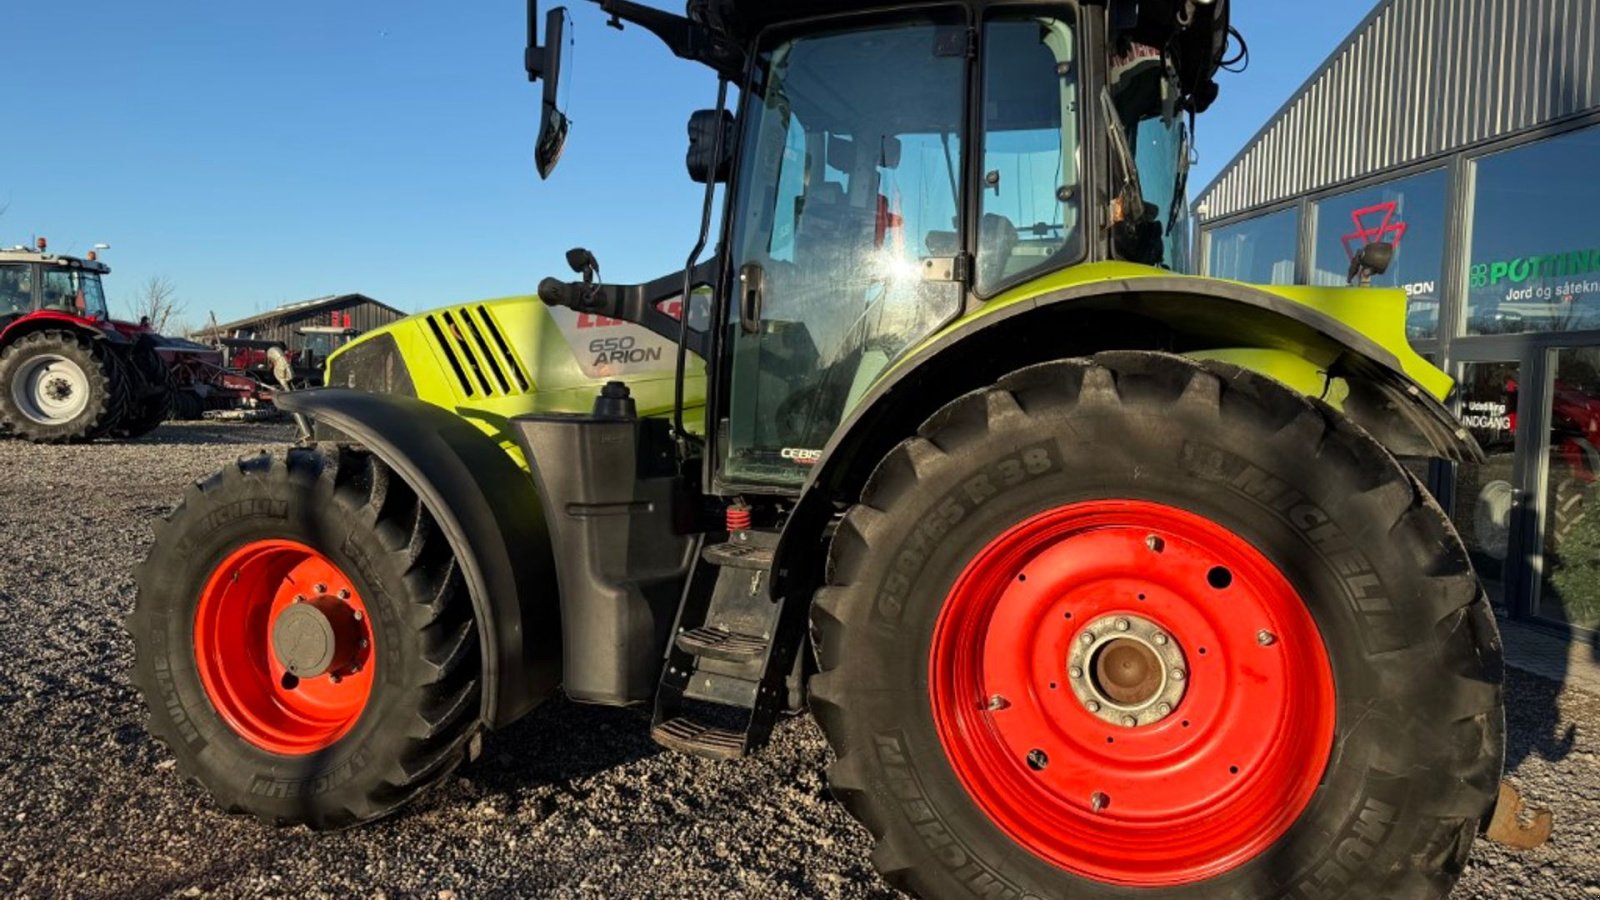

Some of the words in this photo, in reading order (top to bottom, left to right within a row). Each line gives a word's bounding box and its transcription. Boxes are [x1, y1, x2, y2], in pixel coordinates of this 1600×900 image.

[1402, 280, 1434, 296] SON
[1506, 287, 1533, 301] Jord
[1536, 287, 1551, 300] og
[589, 336, 635, 353] 650
[592, 346, 662, 367] ARION
[1462, 415, 1511, 429] INDGANG
[963, 473, 997, 504] R
[997, 448, 1051, 485] 38
